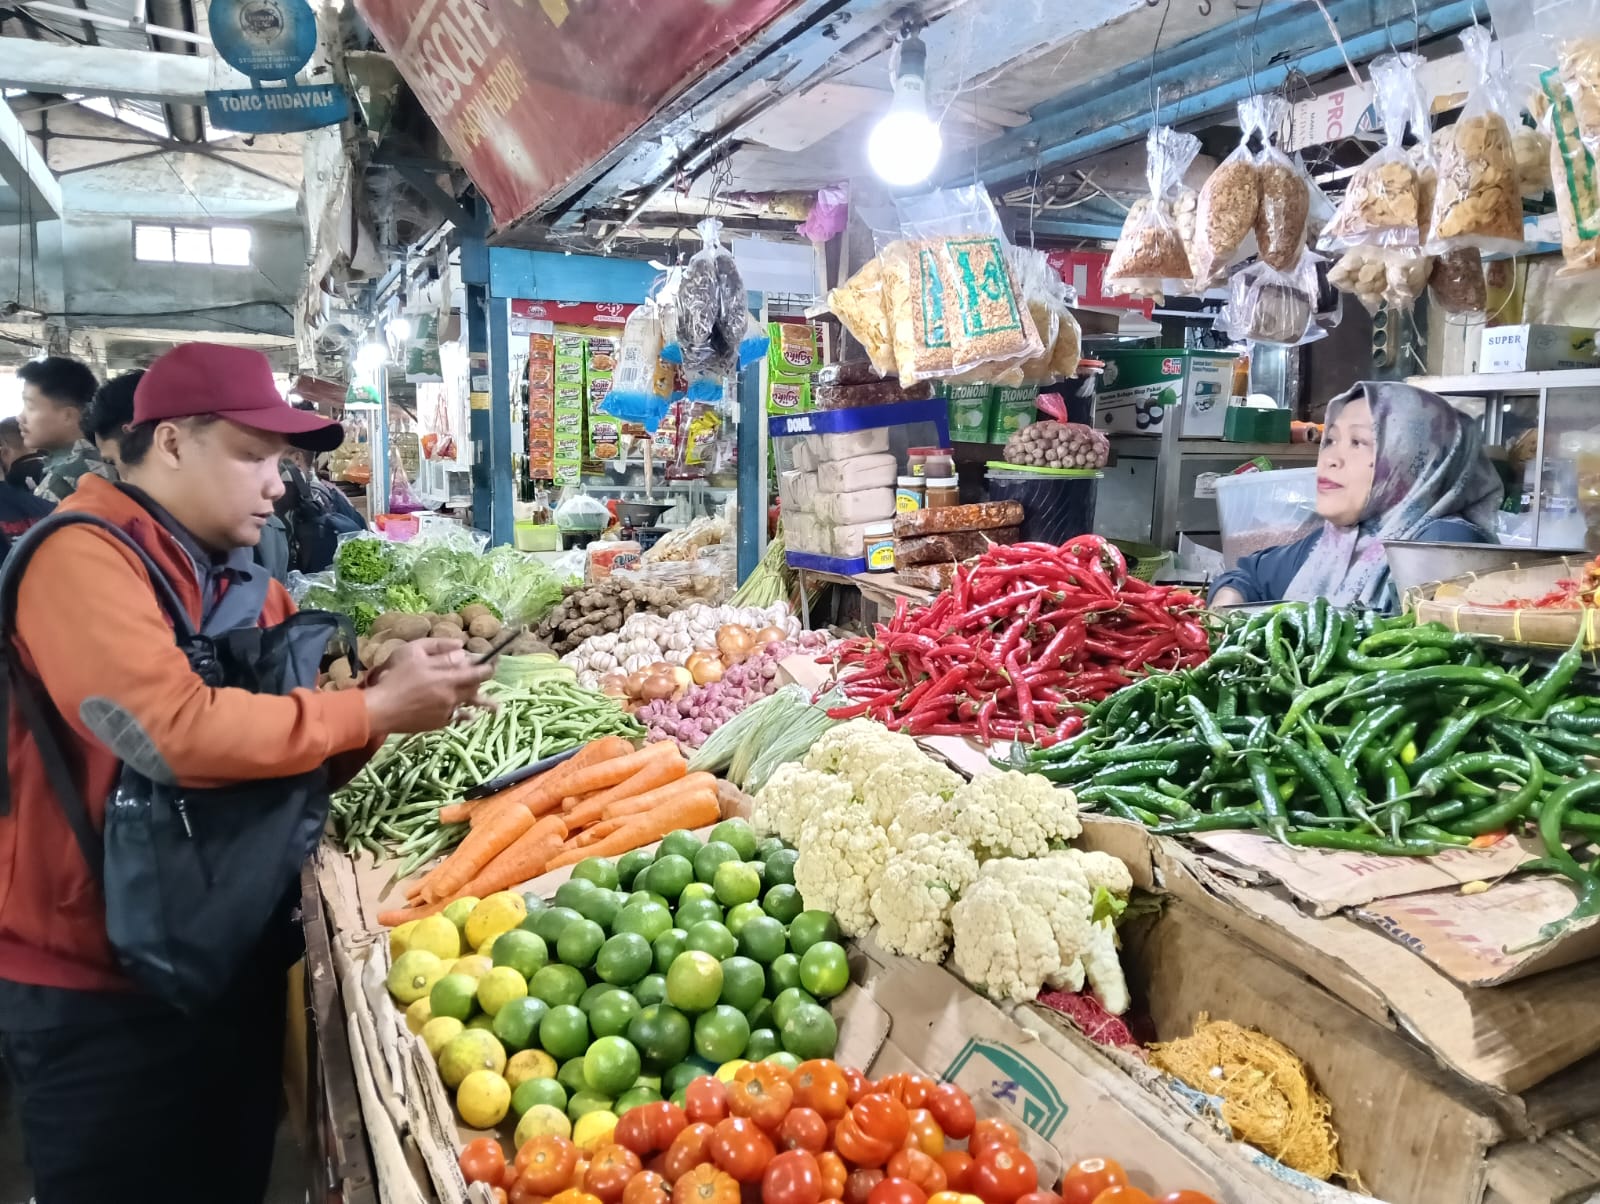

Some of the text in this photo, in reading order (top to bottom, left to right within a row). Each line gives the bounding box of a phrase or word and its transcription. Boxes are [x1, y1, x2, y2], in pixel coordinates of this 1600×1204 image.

[219, 91, 334, 112] TOKO HIDAYAH
[1488, 335, 1521, 345] SUPER
[784, 350, 813, 365] Sajiku
[772, 390, 800, 405] Sajiku
